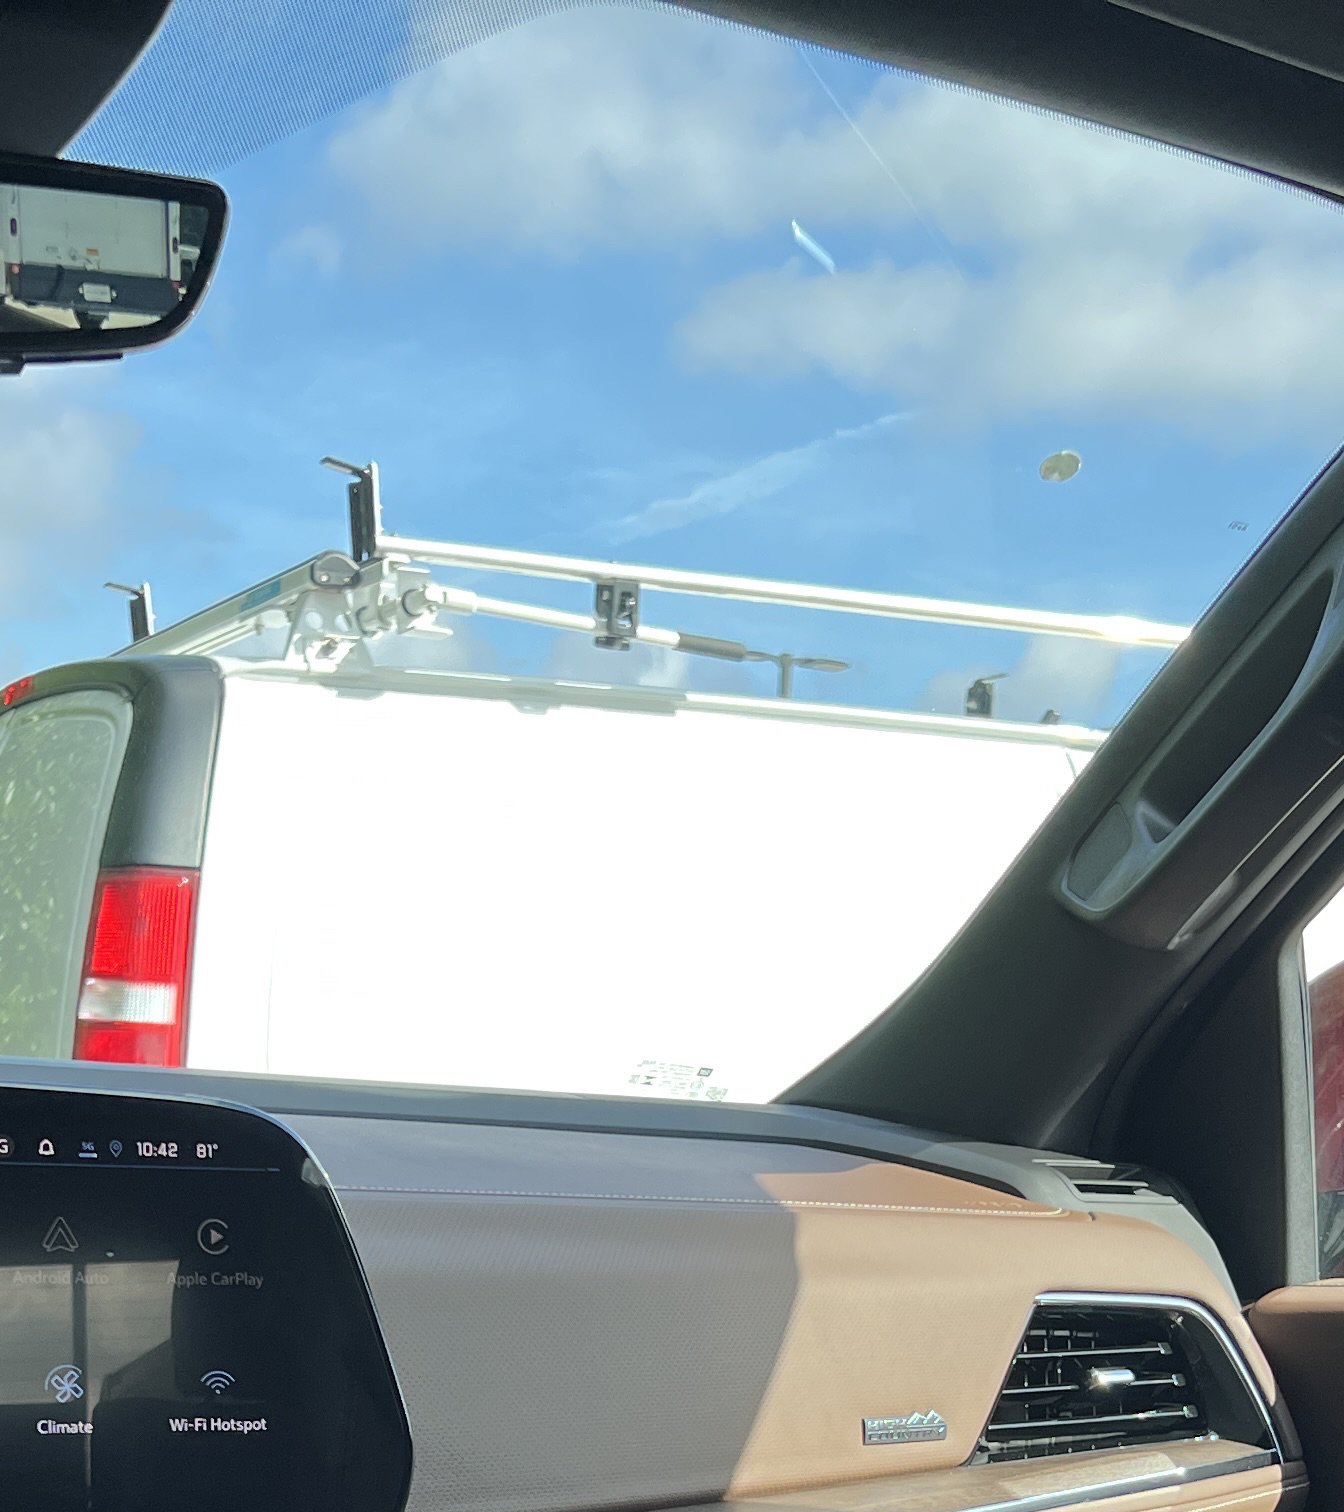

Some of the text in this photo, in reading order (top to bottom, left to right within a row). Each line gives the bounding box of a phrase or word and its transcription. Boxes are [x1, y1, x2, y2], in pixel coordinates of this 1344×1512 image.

[136, 1141, 178, 1158] 10:42
[196, 1143, 219, 1159] 81°
[12, 1269, 109, 1286] Android Auto
[166, 1271, 264, 1290] Apple CarPlay
[36, 1419, 94, 1434] Climate
[168, 1417, 267, 1434] Wi-Fi Hotspot
